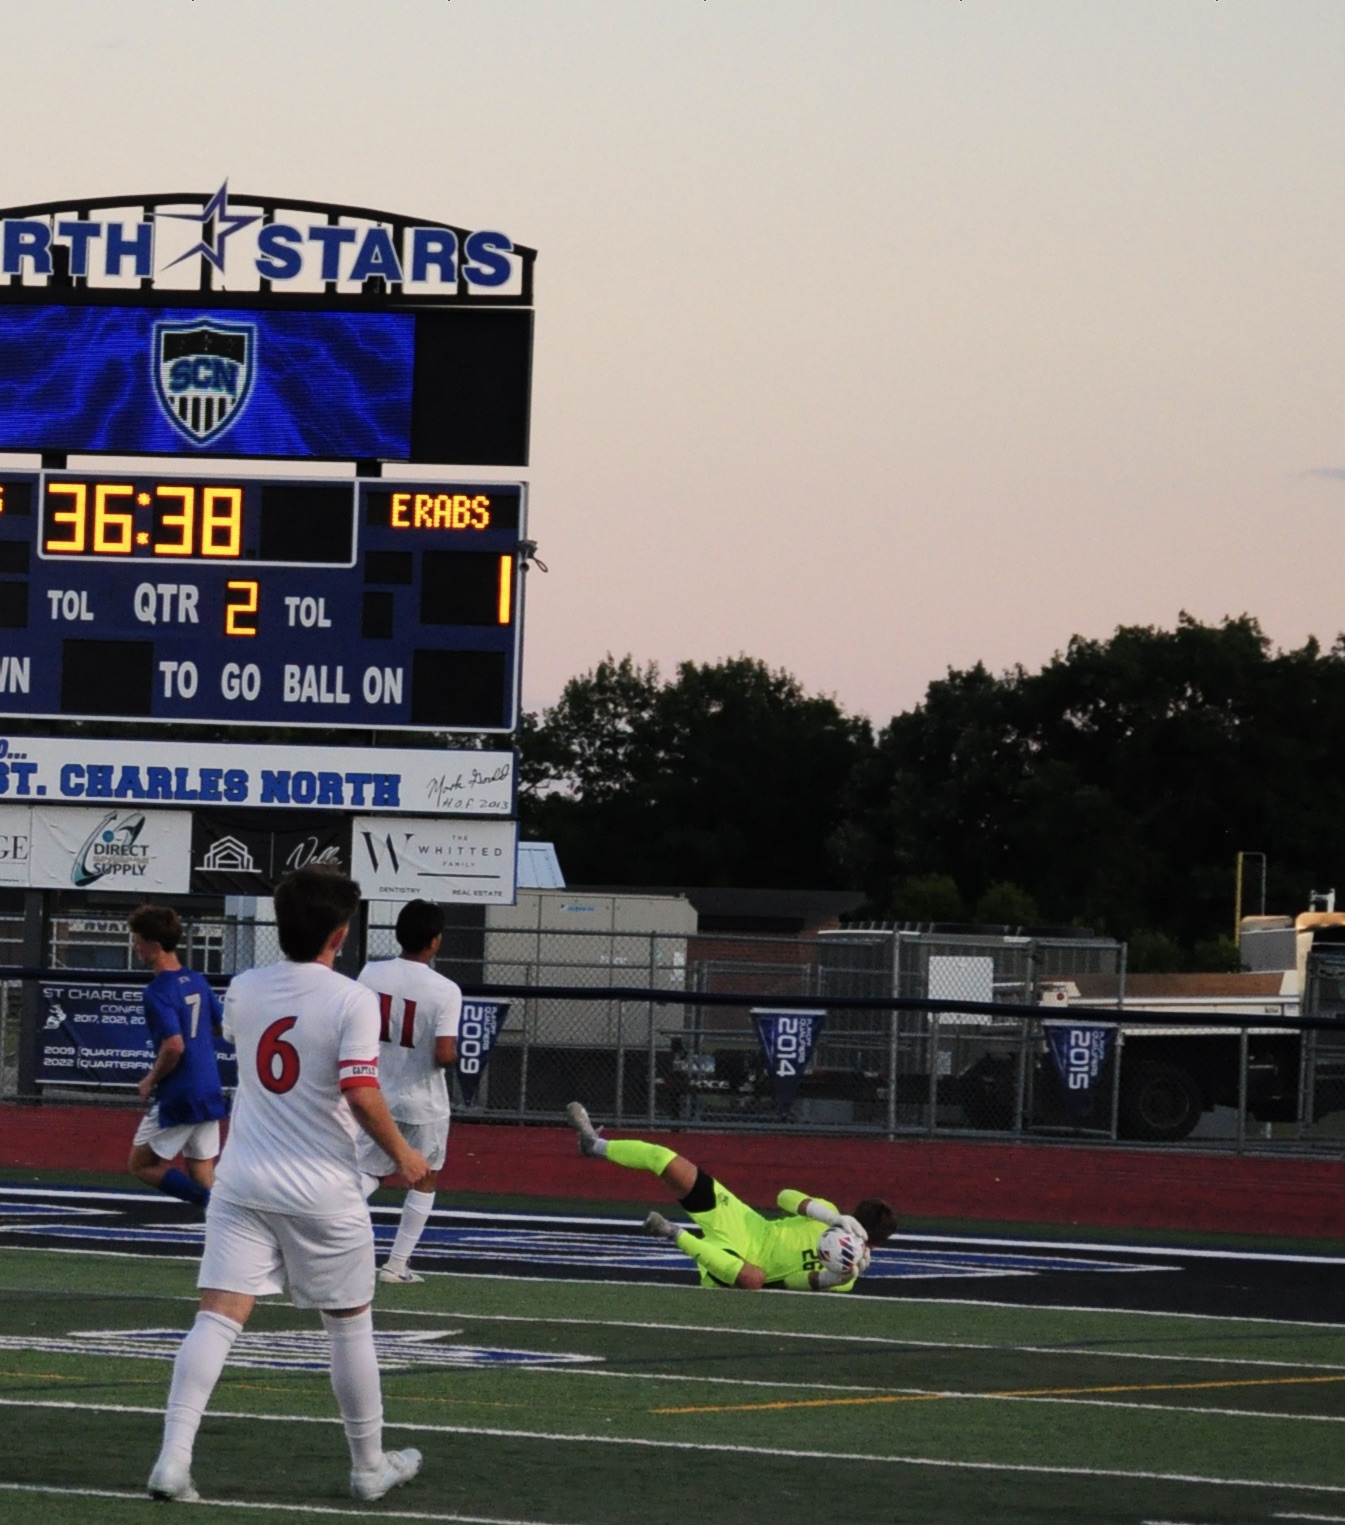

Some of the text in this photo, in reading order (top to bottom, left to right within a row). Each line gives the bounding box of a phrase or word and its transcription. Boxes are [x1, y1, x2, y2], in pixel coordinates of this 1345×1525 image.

[255, 224, 514, 287] STARS
[168, 357, 238, 396] SCN
[46, 483, 243, 557] 36:38
[390, 493, 491, 529] ERABS
[47, 590, 94, 622] TOL
[134, 583, 200, 625] QTR
[225, 580, 259, 636] 2
[498, 555, 513, 625] 1
[285, 596, 332, 629] TOL
[159, 661, 261, 701] TO GO
[283, 664, 404, 705] BALL ON
[59, 763, 250, 803] CHARLES
[260, 769, 402, 807] NORTH
[479, 799, 509, 810] 2013
[93, 843, 150, 857] DIRECT
[93, 862, 148, 877] SUPPLY
[360, 831, 415, 875] W
[418, 845, 503, 857] WHITTED
[379, 886, 421, 894] DENTISTRY
[452, 888, 503, 897] REAL ESTATE
[42, 988, 144, 1002] ST CHARLES
[100, 1004, 145, 1014] CONFE
[130, 1016, 146, 1025] 20
[184, 992, 201, 1039] 7
[377, 991, 418, 1050] 11
[43, 1046, 156, 1060] 2009 (QUARTERFIN
[256, 1015, 301, 1095] 6
[459, 1005, 484, 1074] 2009
[776, 1017, 798, 1077] 2014
[43, 1057, 154, 1070] 2022 (QUARTERFIN
[1068, 1030, 1091, 1090] 2015
